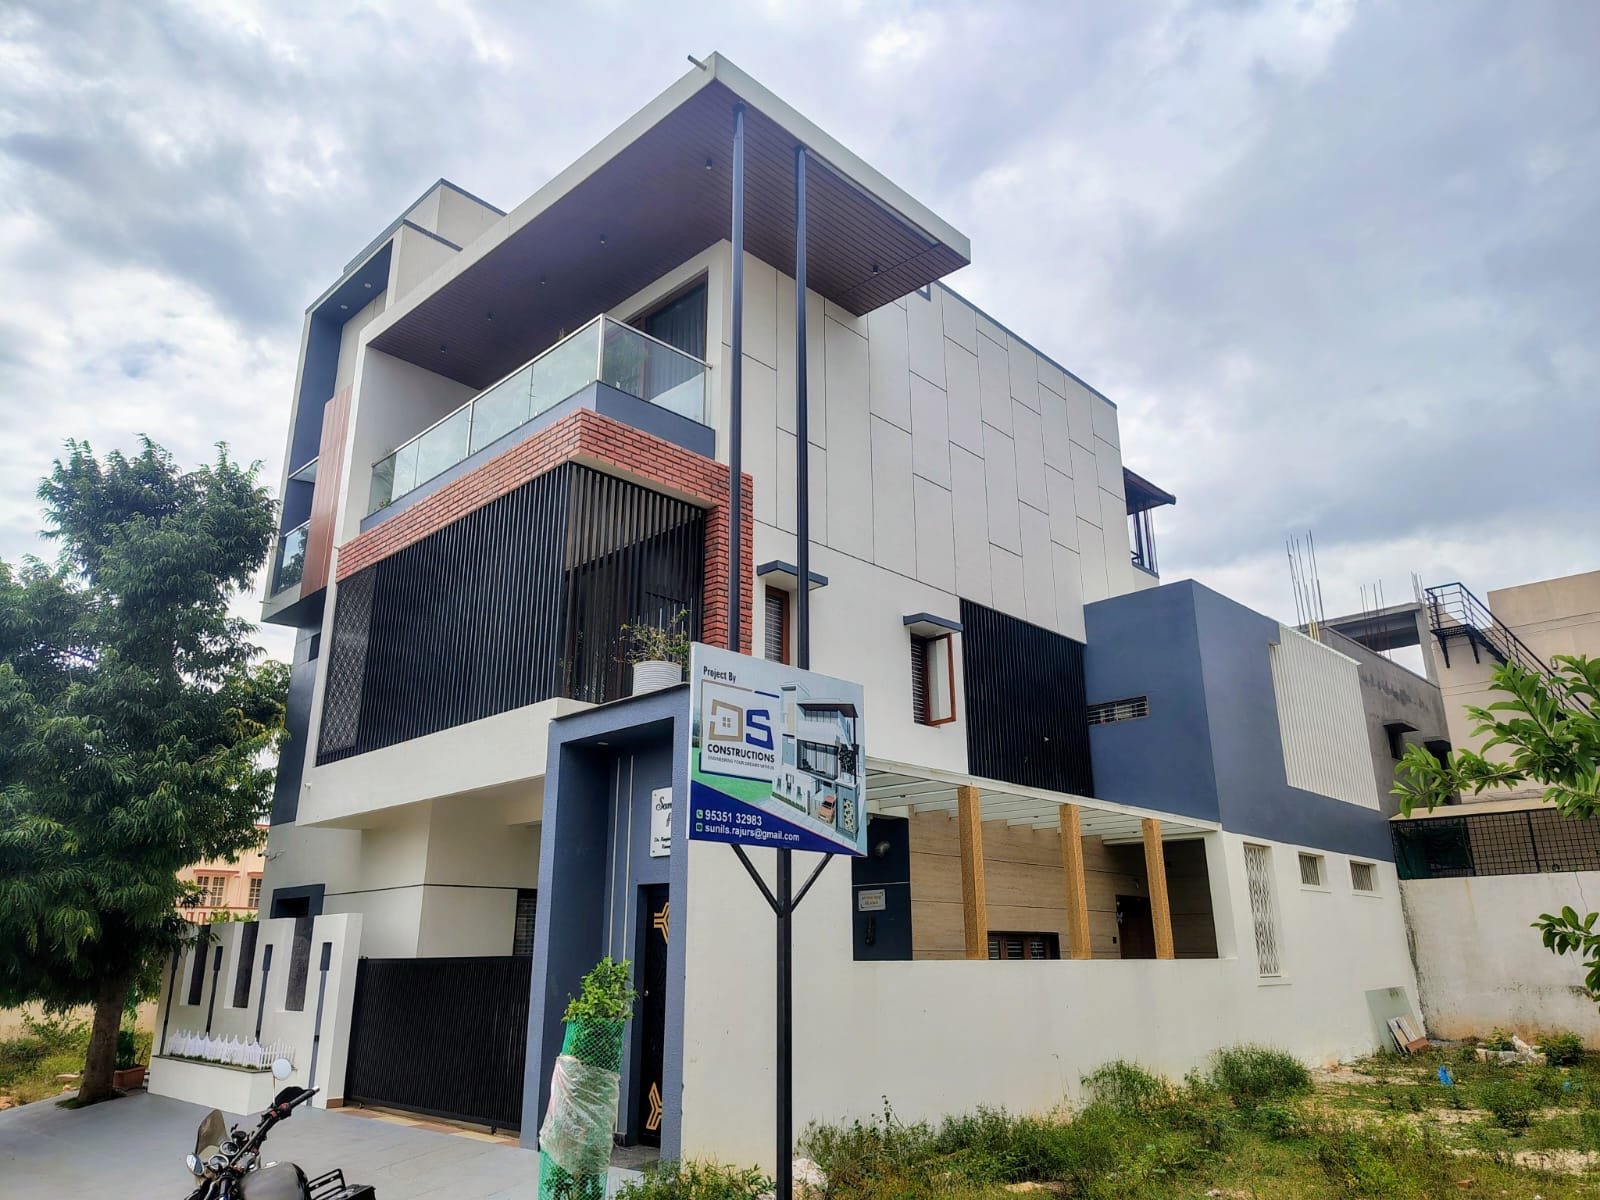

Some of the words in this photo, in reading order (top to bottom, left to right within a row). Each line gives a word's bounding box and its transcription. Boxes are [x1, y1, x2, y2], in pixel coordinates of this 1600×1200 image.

[703, 666, 727, 680] Project
[728, 671, 737, 684] By
[707, 743, 775, 763] CONSTRUCTIONS
[705, 809, 732, 822] 95351
[735, 813, 762, 826] 32983
[704, 824, 800, 841] sunils.rajurs@gmail.com
